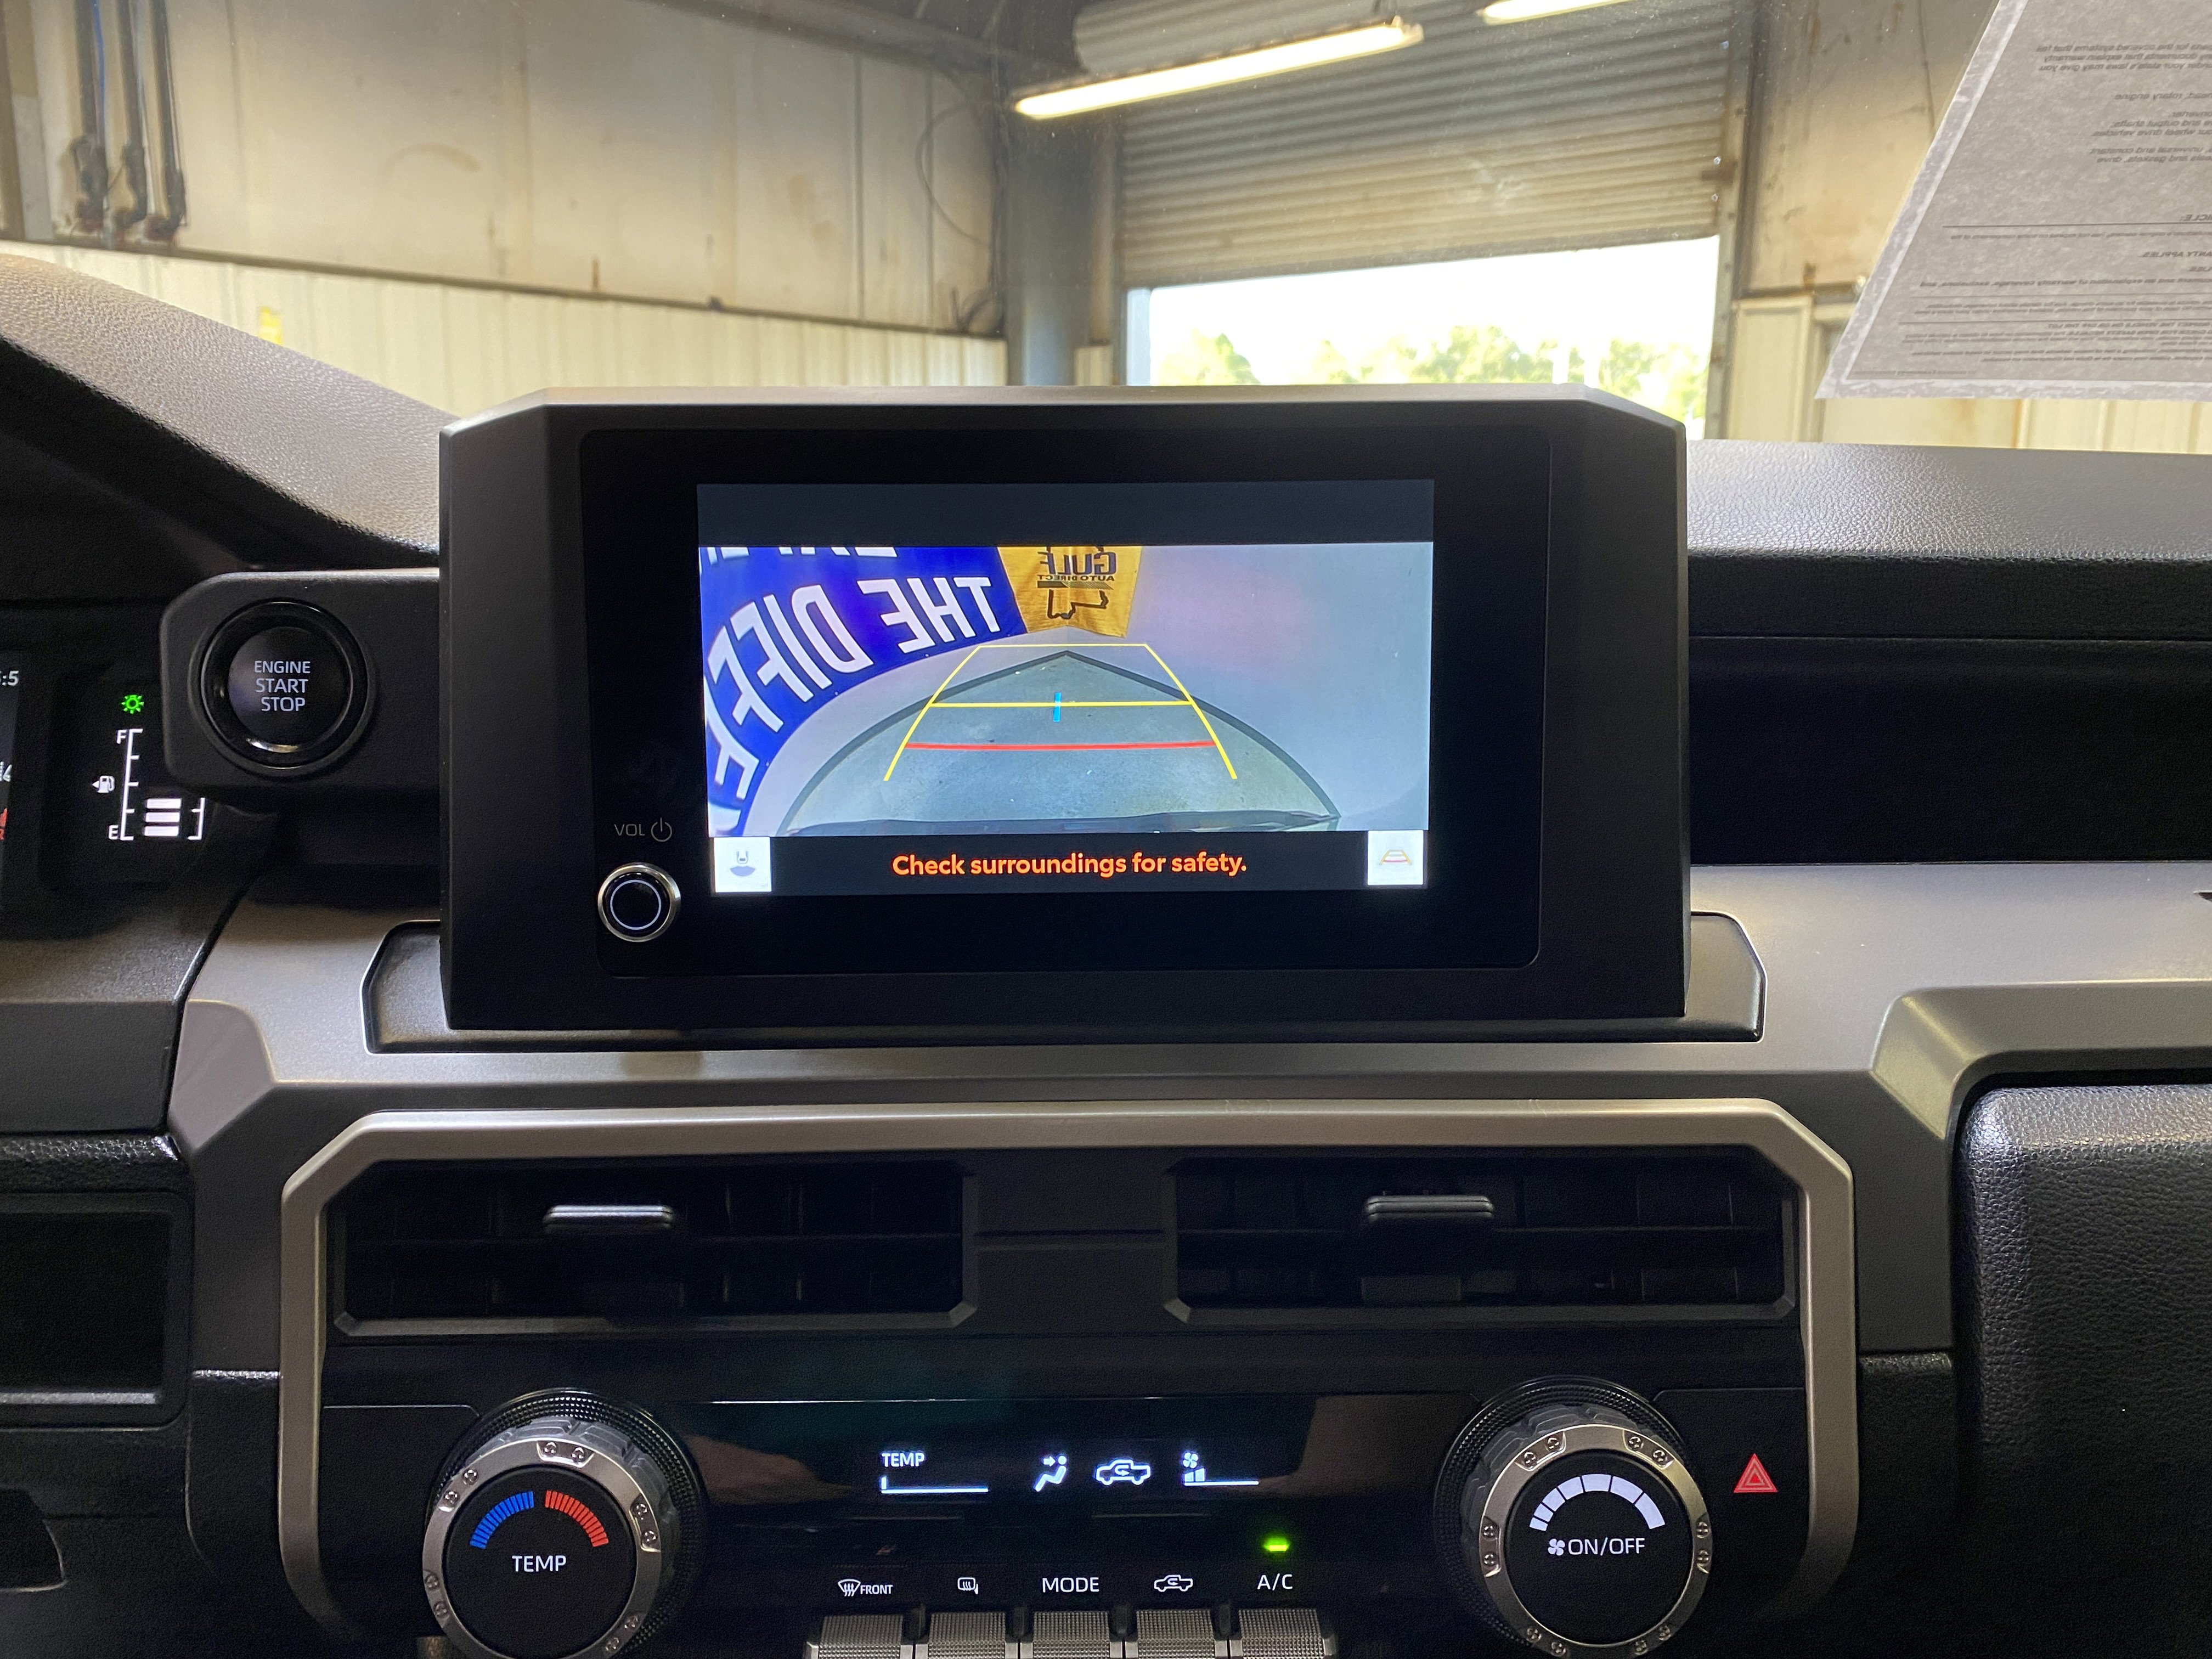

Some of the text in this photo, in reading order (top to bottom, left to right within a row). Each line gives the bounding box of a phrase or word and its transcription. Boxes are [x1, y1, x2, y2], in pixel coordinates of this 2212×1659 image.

[254, 661, 311, 674] ENGINE
[256, 678, 309, 693] START
[261, 696, 306, 712] STOP
[116, 729, 127, 744] F
[108, 825, 119, 840] E
[614, 824, 646, 836] VOL
[892, 851, 1247, 878] Check surroundings for safety.
[882, 1452, 925, 1468] TEMP
[1567, 1537, 1645, 1556] ON/OFF
[512, 1555, 567, 1573] TEMP
[860, 1584, 894, 1595] FRONT
[1042, 1577, 1100, 1593] MODE
[1257, 1573, 1294, 1590] A/C
